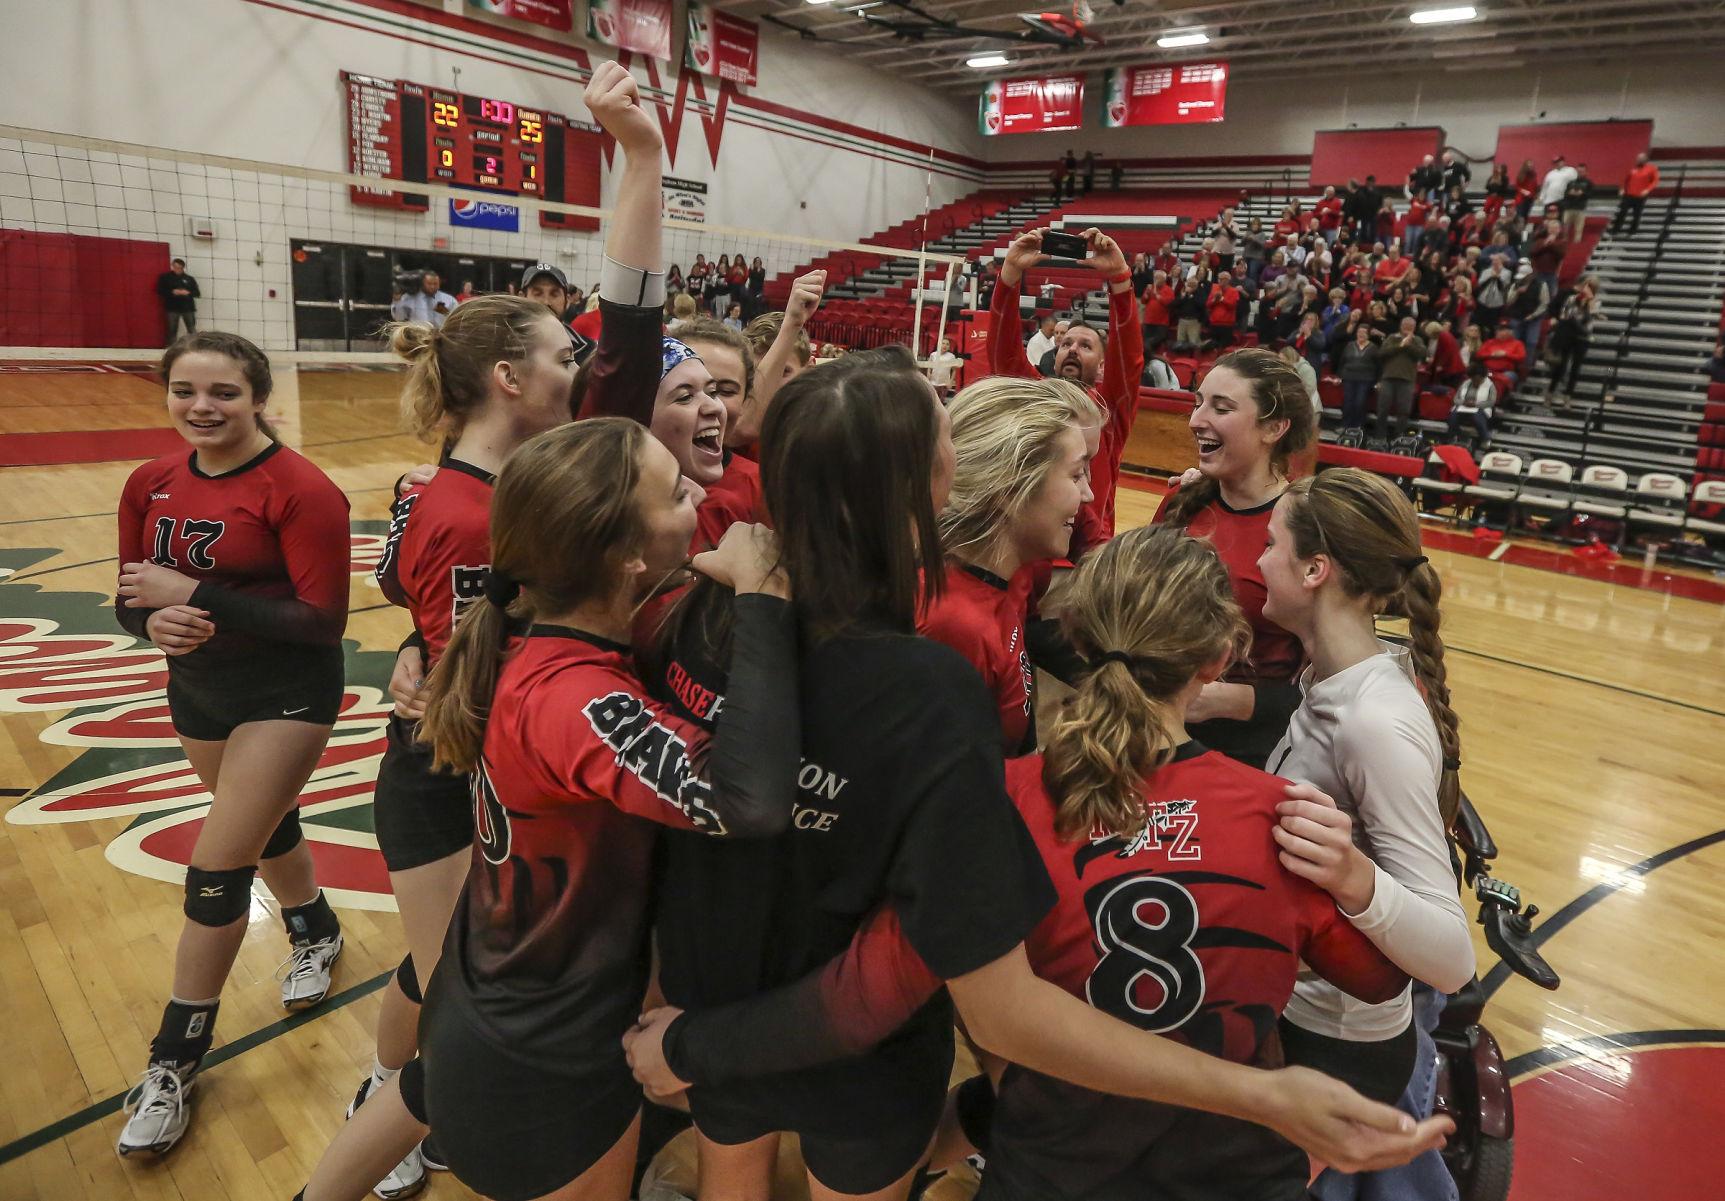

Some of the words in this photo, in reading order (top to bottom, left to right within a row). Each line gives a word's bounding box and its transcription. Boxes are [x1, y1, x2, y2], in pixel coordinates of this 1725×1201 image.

[434, 102, 459, 128] 22
[520, 120, 543, 143] 25
[442, 149, 453, 167] 0
[486, 157, 497, 174] 2
[530, 165, 536, 179] 1
[480, 203, 517, 217] pepsi
[151, 516, 225, 570] 17
[666, 661, 715, 718] CHASE
[1086, 876, 1206, 1034] 8
